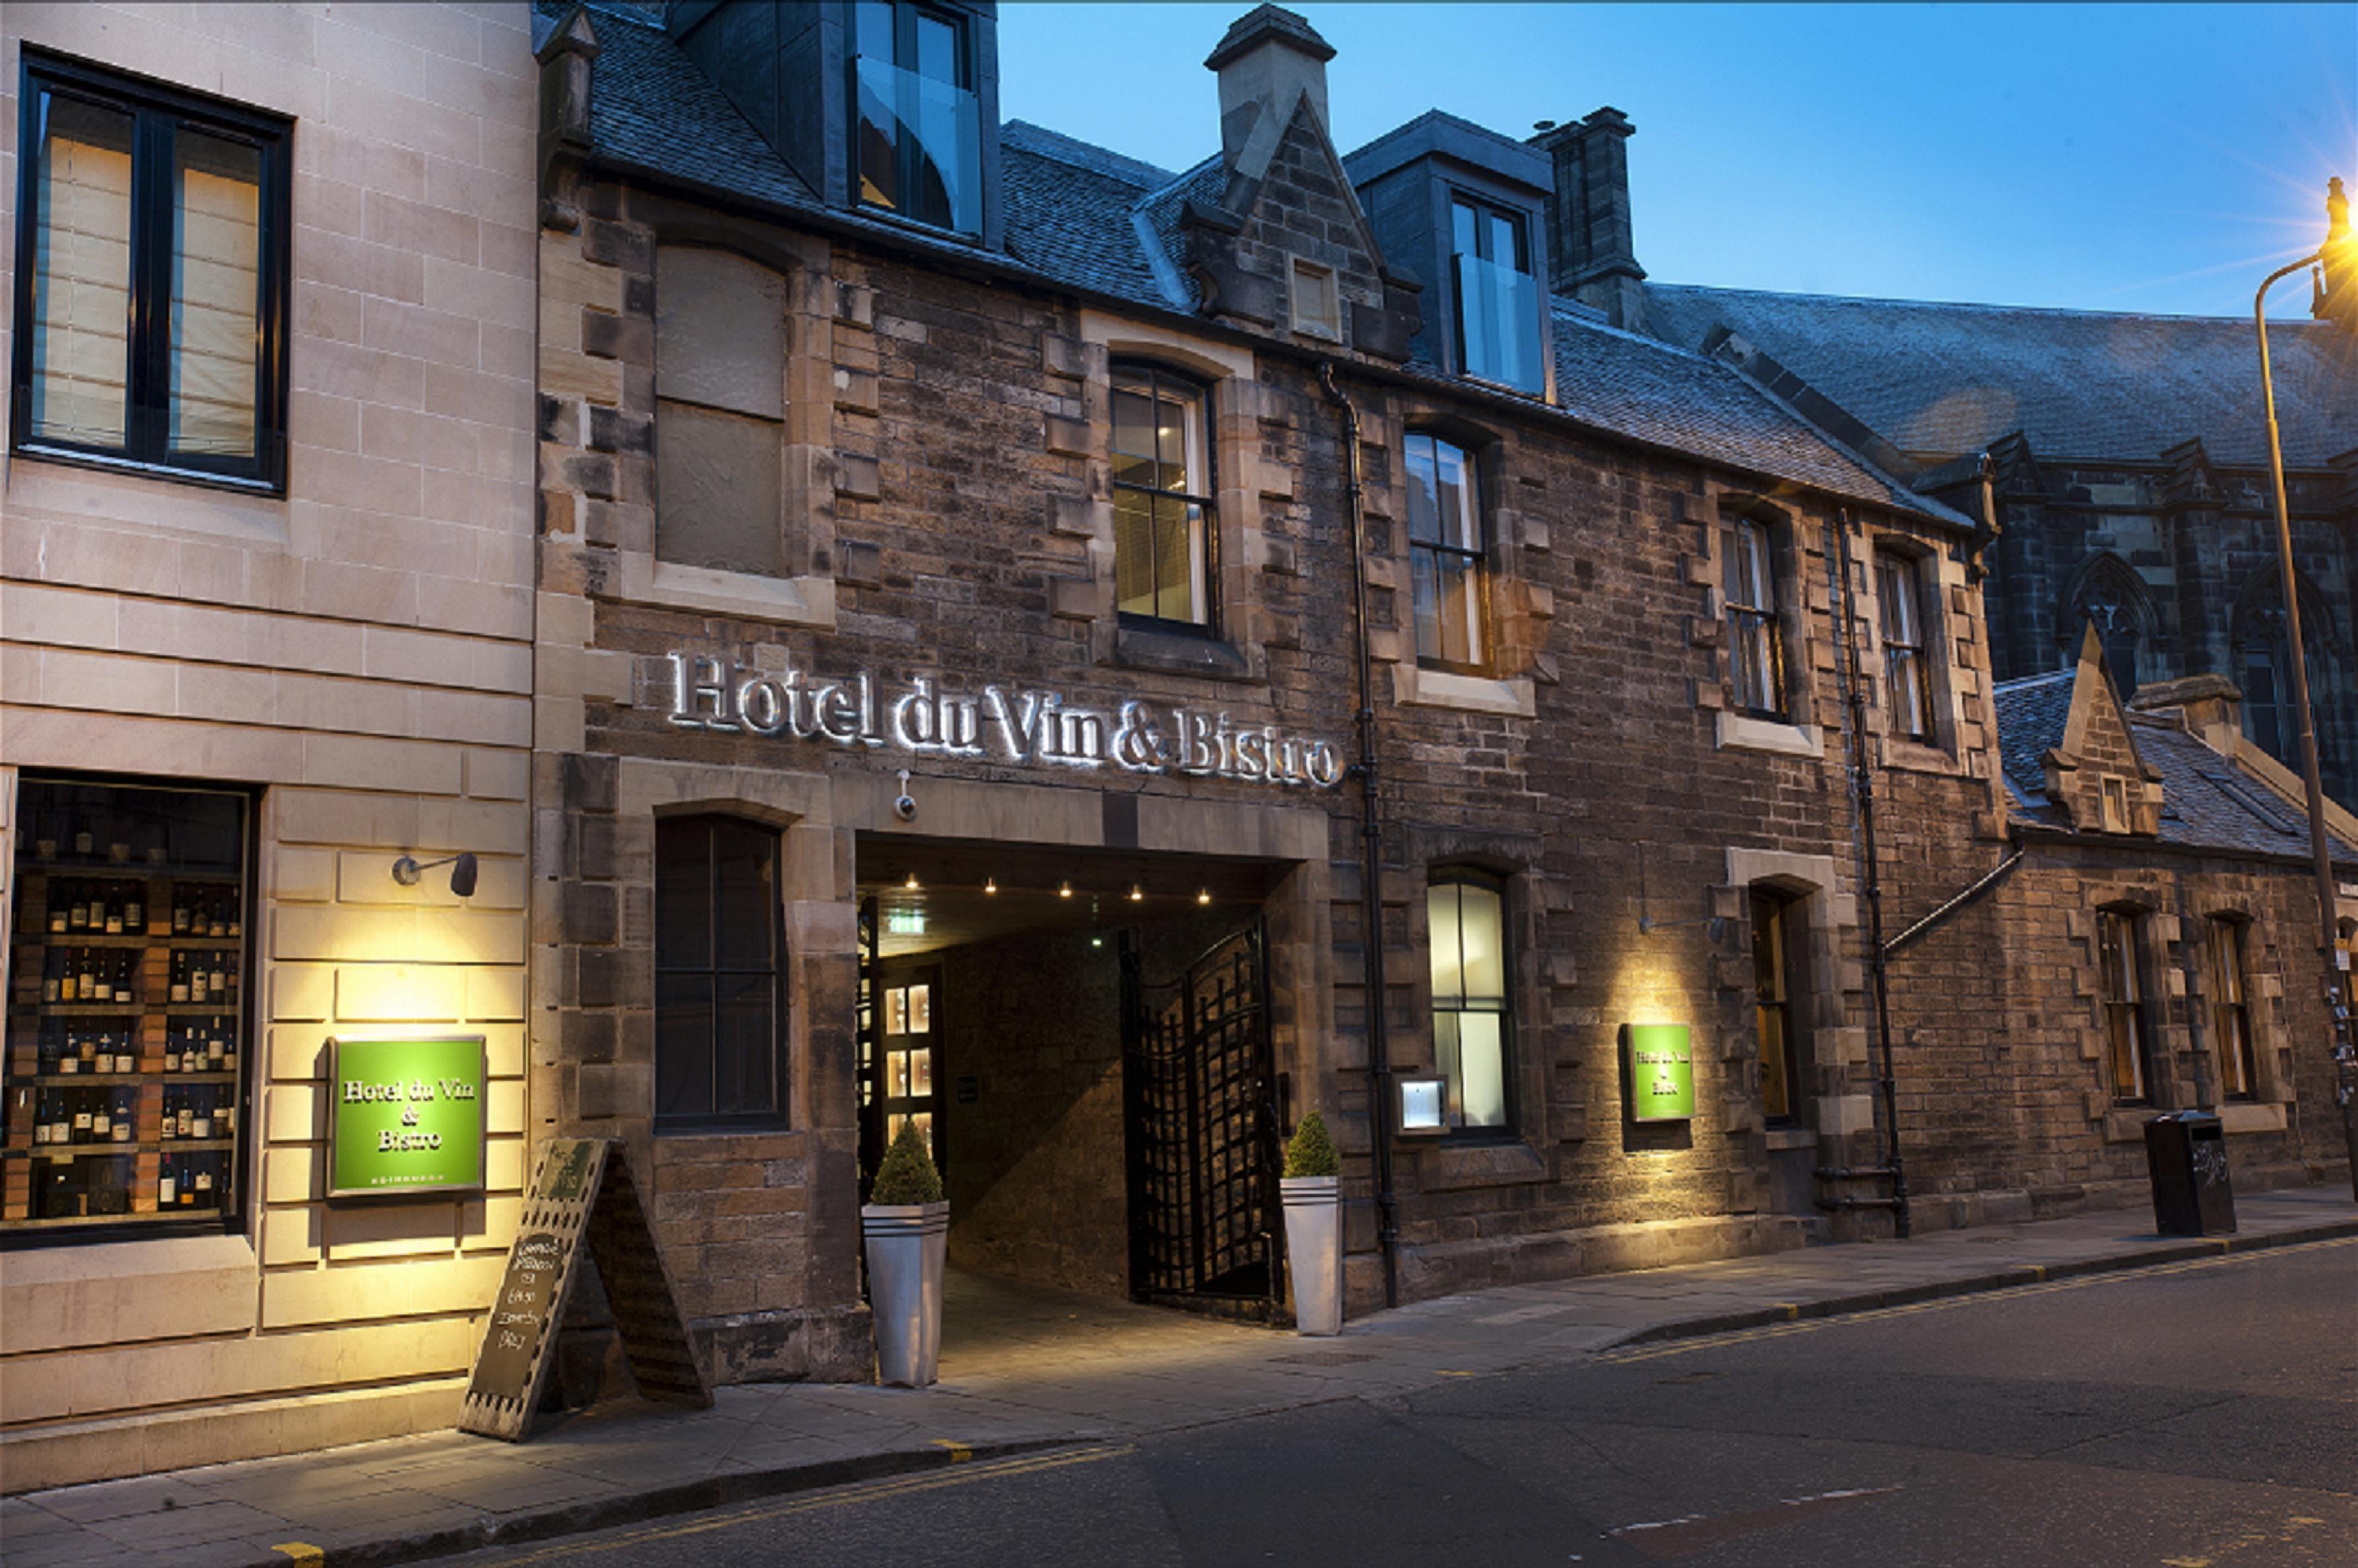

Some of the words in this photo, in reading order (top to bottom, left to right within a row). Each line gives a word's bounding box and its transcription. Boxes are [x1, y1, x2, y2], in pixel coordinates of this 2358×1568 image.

[667, 649, 887, 746] Hotel
[895, 676, 985, 756] du
[985, 685, 1107, 767] Vin
[1113, 701, 1169, 773] &
[1172, 708, 1346, 788] Bistro
[343, 1080, 403, 1103] Hotel
[409, 1079, 434, 1101] du
[438, 1078, 475, 1100] Vin
[401, 1105, 420, 1127] &
[377, 1129, 442, 1152] Bistro
